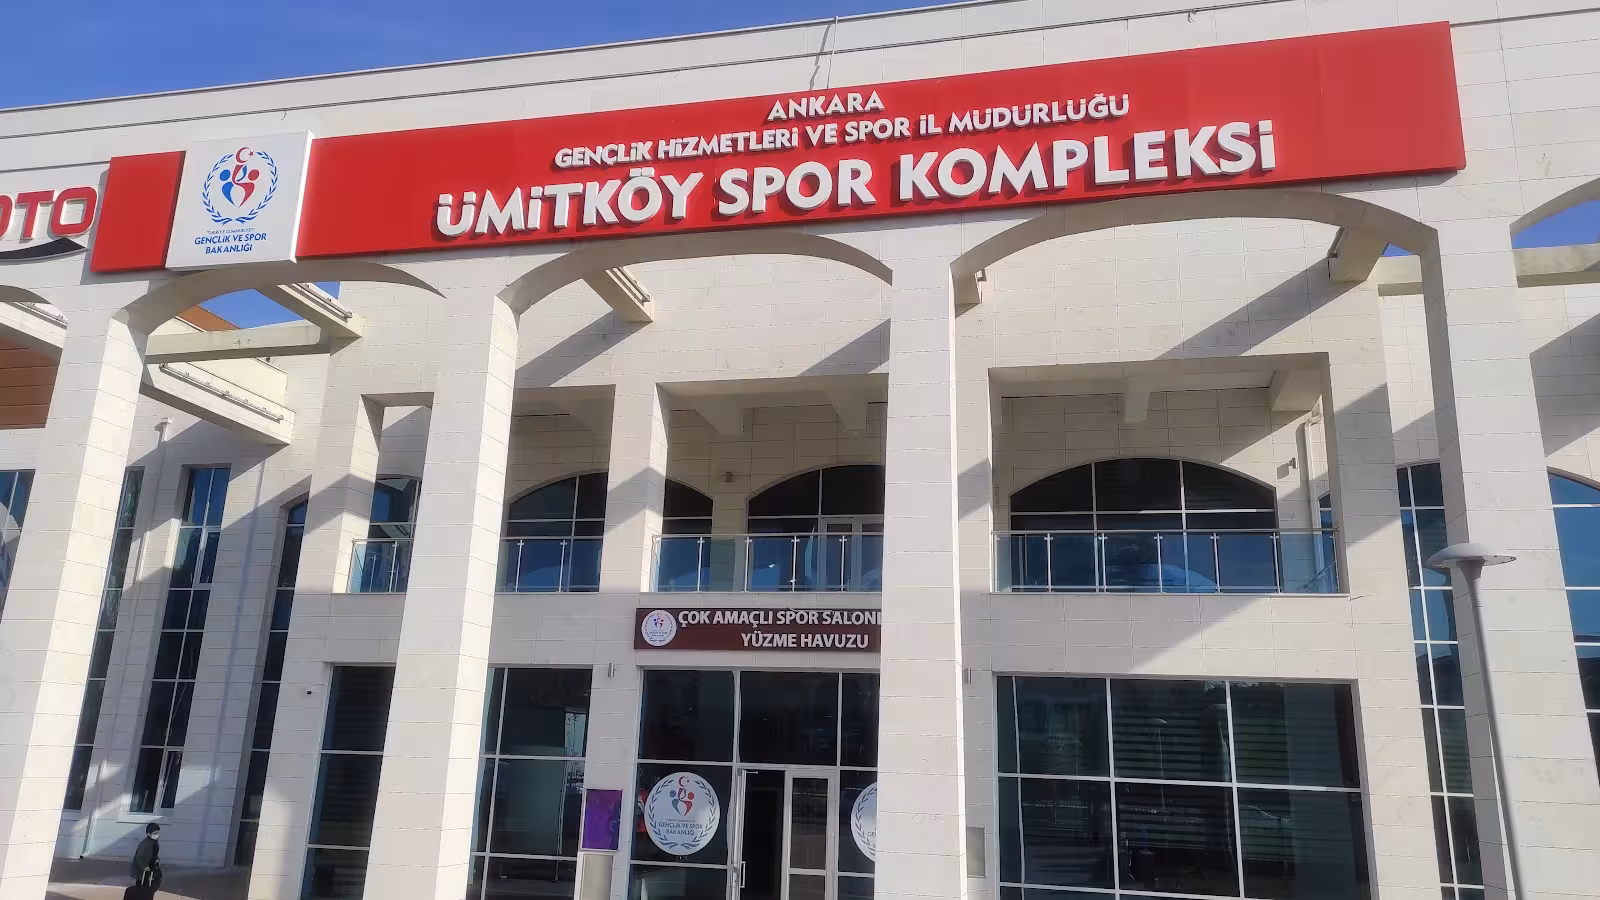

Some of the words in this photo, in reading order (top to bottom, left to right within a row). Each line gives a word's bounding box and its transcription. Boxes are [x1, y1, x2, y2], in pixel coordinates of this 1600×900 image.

[767, 90, 885, 121] ANKARA
[806, 123, 838, 147] VE
[845, 117, 910, 144] SPOR
[949, 93, 1129, 133] MÜDÜRLÜĞÜ
[718, 158, 877, 217] SPOR
[244, 233, 267, 241] SPOR
[205, 243, 252, 254] BAKANLIĞI
[678, 610, 710, 628] ÇOK
[713, 610, 773, 628] AMAÇLI
[776, 610, 819, 625] SPOR
[741, 631, 797, 648] YÜZME
[801, 633, 869, 649] HAVUZU
